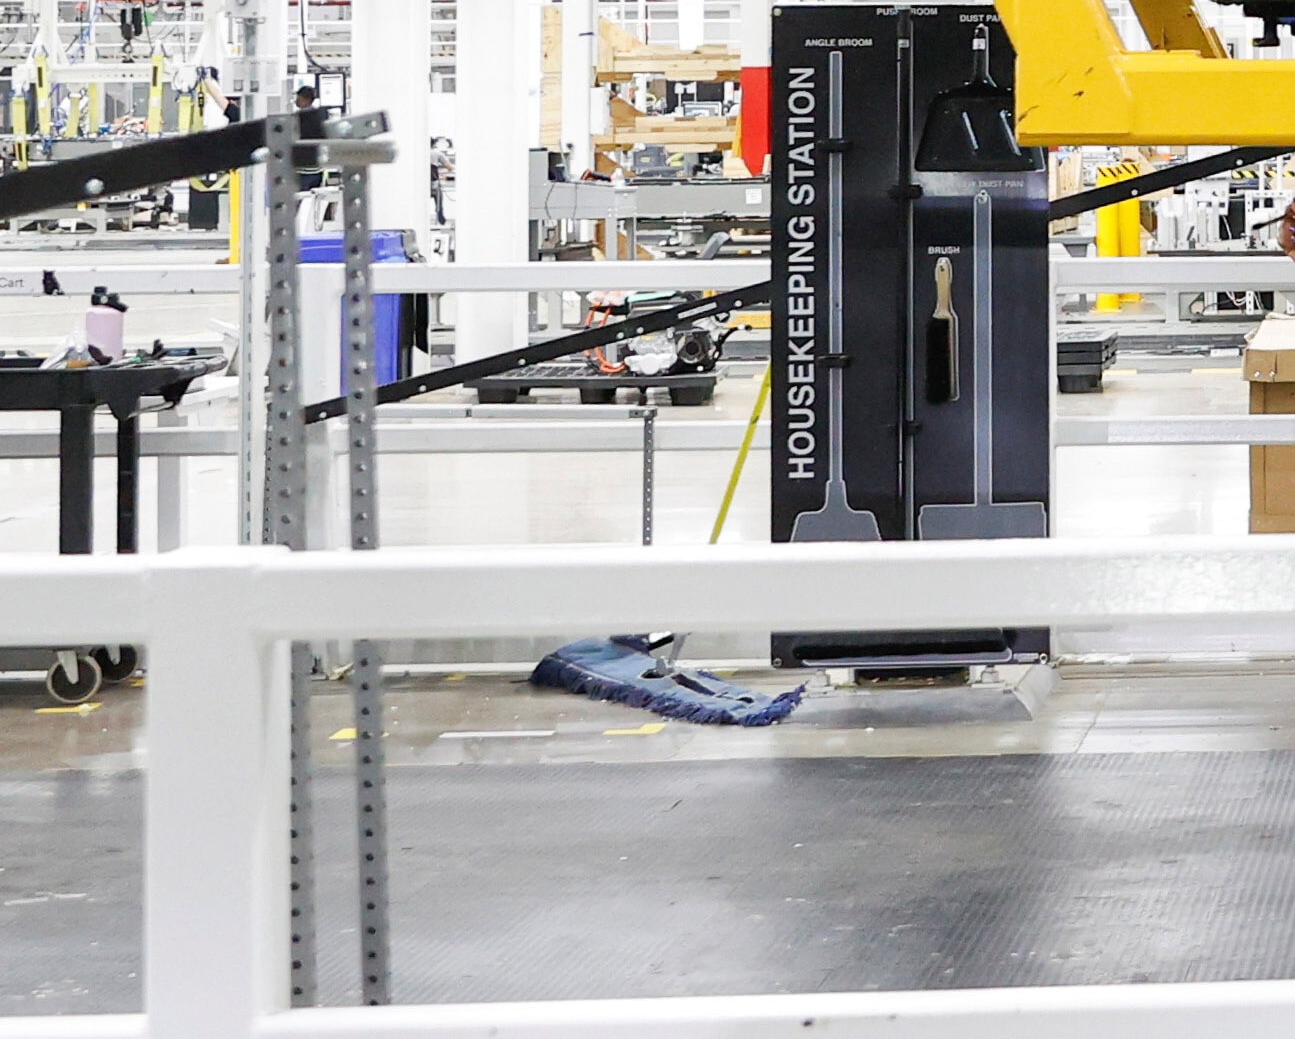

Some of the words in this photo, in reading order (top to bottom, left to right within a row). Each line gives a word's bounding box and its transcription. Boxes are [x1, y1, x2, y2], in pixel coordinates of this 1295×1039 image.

[910, 7, 938, 16] ROOM
[959, 14, 984, 23] DUST
[985, 14, 1001, 23] PA
[804, 39, 834, 47] ANGLE
[837, 38, 873, 47] BROOM
[787, 67, 816, 206] STATION
[928, 246, 960, 255] BRUSH
[0, 277, 24, 288] Cart
[787, 216, 816, 480] HOUSEKEEPING
